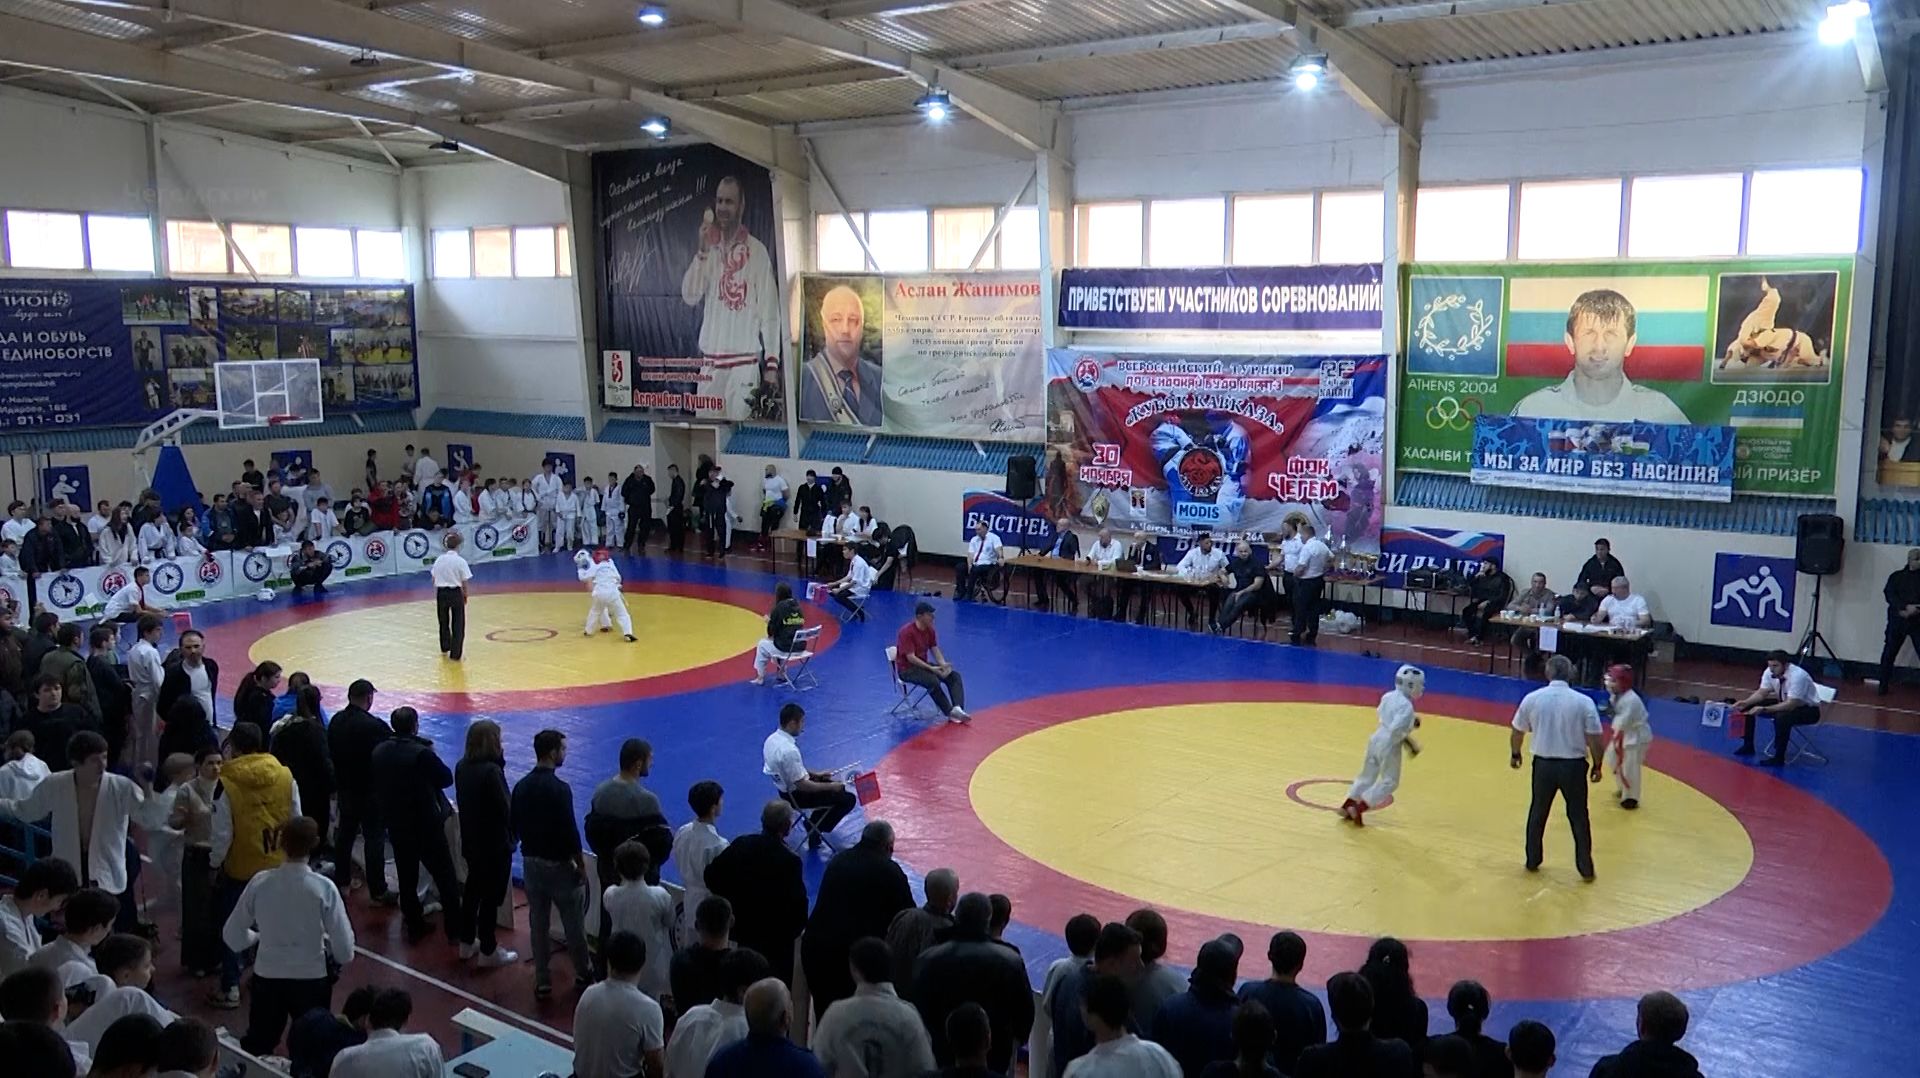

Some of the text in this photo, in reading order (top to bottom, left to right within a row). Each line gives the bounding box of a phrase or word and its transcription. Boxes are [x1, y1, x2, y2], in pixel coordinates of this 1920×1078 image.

[895, 280, 1042, 298] Аслан Жанимов
[1068, 278, 1383, 313] ПРИВЕТСТВУЕМ УЧАСТНИКОВ СОРЕВНОВАНИЙ!
[23, 332, 33, 343] И
[37, 331, 87, 343] ОБУВЬ
[3, 346, 112, 361] ЕДИНОБОРСТВ
[1117, 360, 1294, 378] ВСЕРОССИЙСКИЙ ТУРНИР
[1408, 377, 1498, 395] ATHENS 2004
[633, 388, 682, 409] Асланбек
[683, 392, 725, 412] Хуштов
[1733, 391, 1805, 407] ДЗЮДО
[1093, 443, 1120, 466] 30
[1403, 446, 1461, 462] ХАСАНБИ
[1287, 457, 1330, 477] ФОК
[1483, 453, 1721, 484] МЫ ЗА МИР БЕЗ НАСИЛИЯ
[1757, 467, 1822, 484] ПРИЗЁР
[1080, 466, 1133, 487] НОЯБРЯ
[1268, 472, 1339, 501] ЧЕГЕМ
[1179, 504, 1220, 519] MODIS
